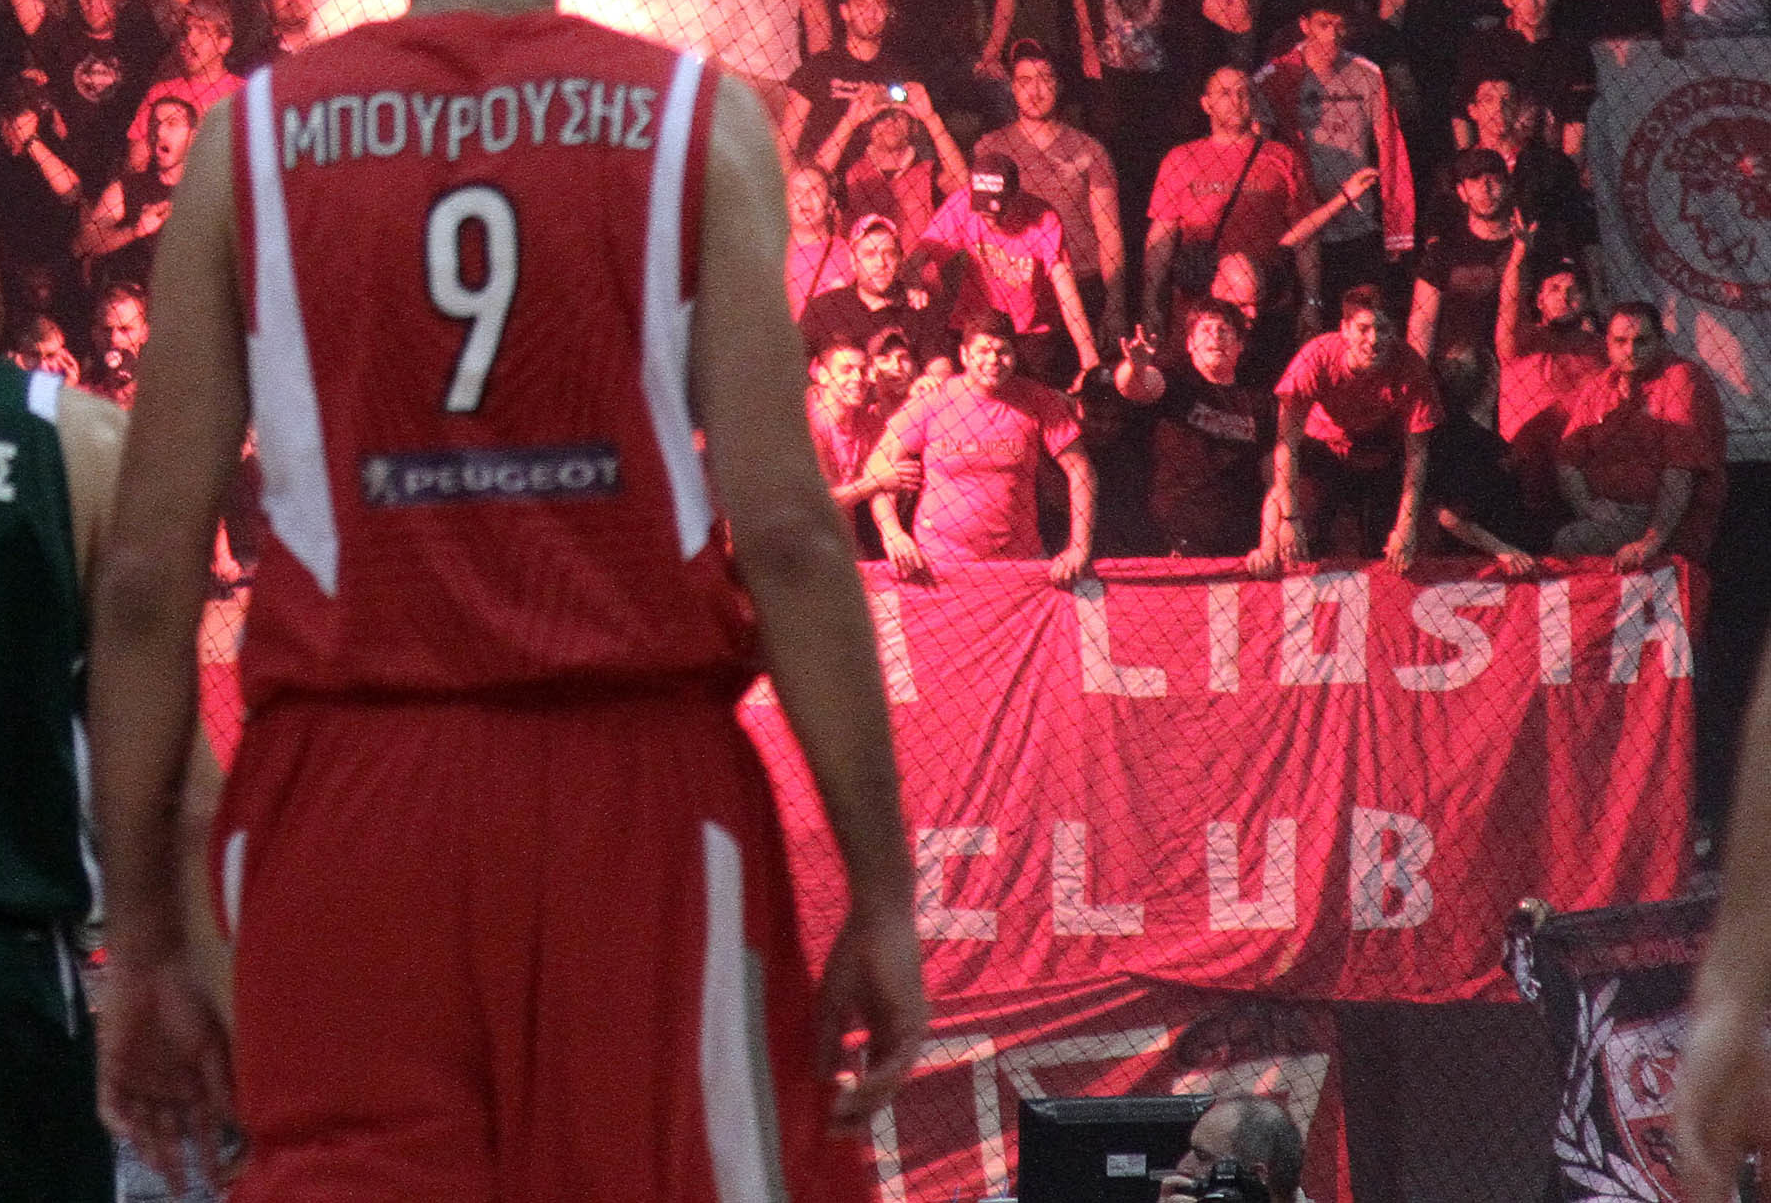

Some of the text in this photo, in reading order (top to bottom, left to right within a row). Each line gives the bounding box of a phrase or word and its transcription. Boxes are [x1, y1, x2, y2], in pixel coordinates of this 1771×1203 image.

[283, 78, 658, 169] ΜΠΟΥΡΟΥΣΗΣ
[425, 185, 519, 414] 9
[403, 456, 619, 496] PEUGEOT
[1076, 565, 1696, 698] LIOSIA
[914, 805, 1435, 942] CLUB
